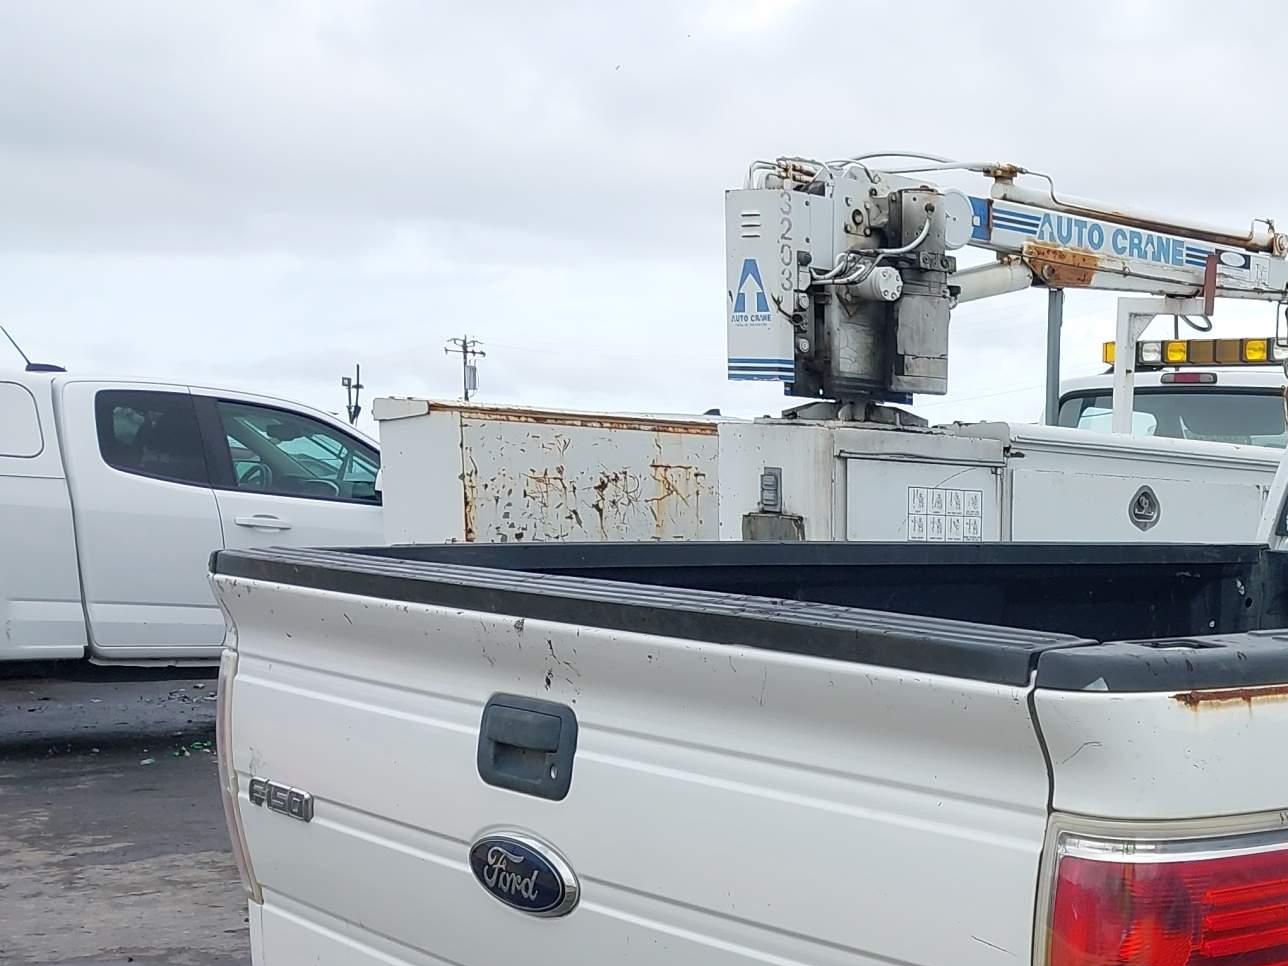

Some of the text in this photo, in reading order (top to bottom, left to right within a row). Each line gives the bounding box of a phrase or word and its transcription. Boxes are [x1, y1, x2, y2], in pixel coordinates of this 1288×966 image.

[1038, 212, 1185, 266] AUTO CRANE
[731, 313, 772, 322] AUTO CRANE
[483, 846, 539, 901] Ford
